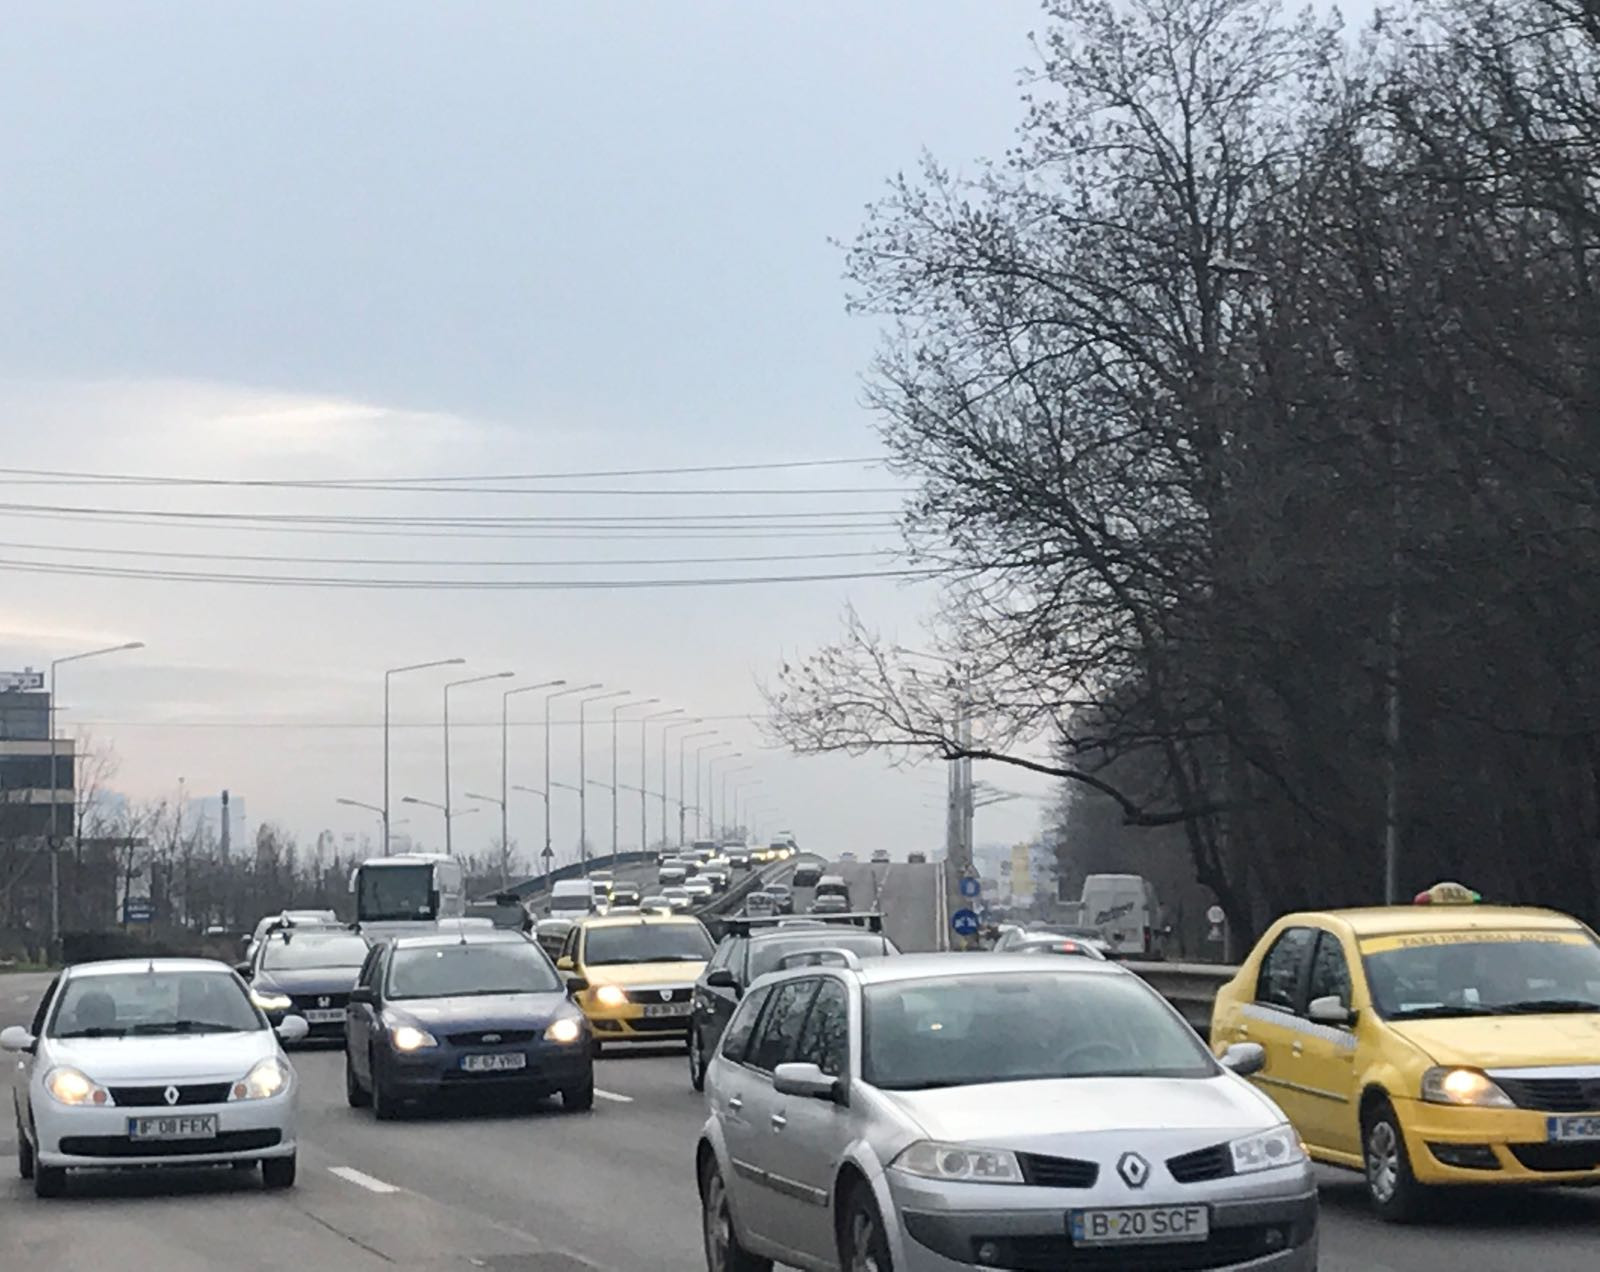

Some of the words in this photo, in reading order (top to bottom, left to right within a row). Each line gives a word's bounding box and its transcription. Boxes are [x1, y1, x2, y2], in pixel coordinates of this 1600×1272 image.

[1399, 935, 1436, 946] TAXI
[1092, 1213, 1109, 1236] B
[1118, 1211, 1146, 1235] 20
[1151, 1209, 1200, 1234] SCF
